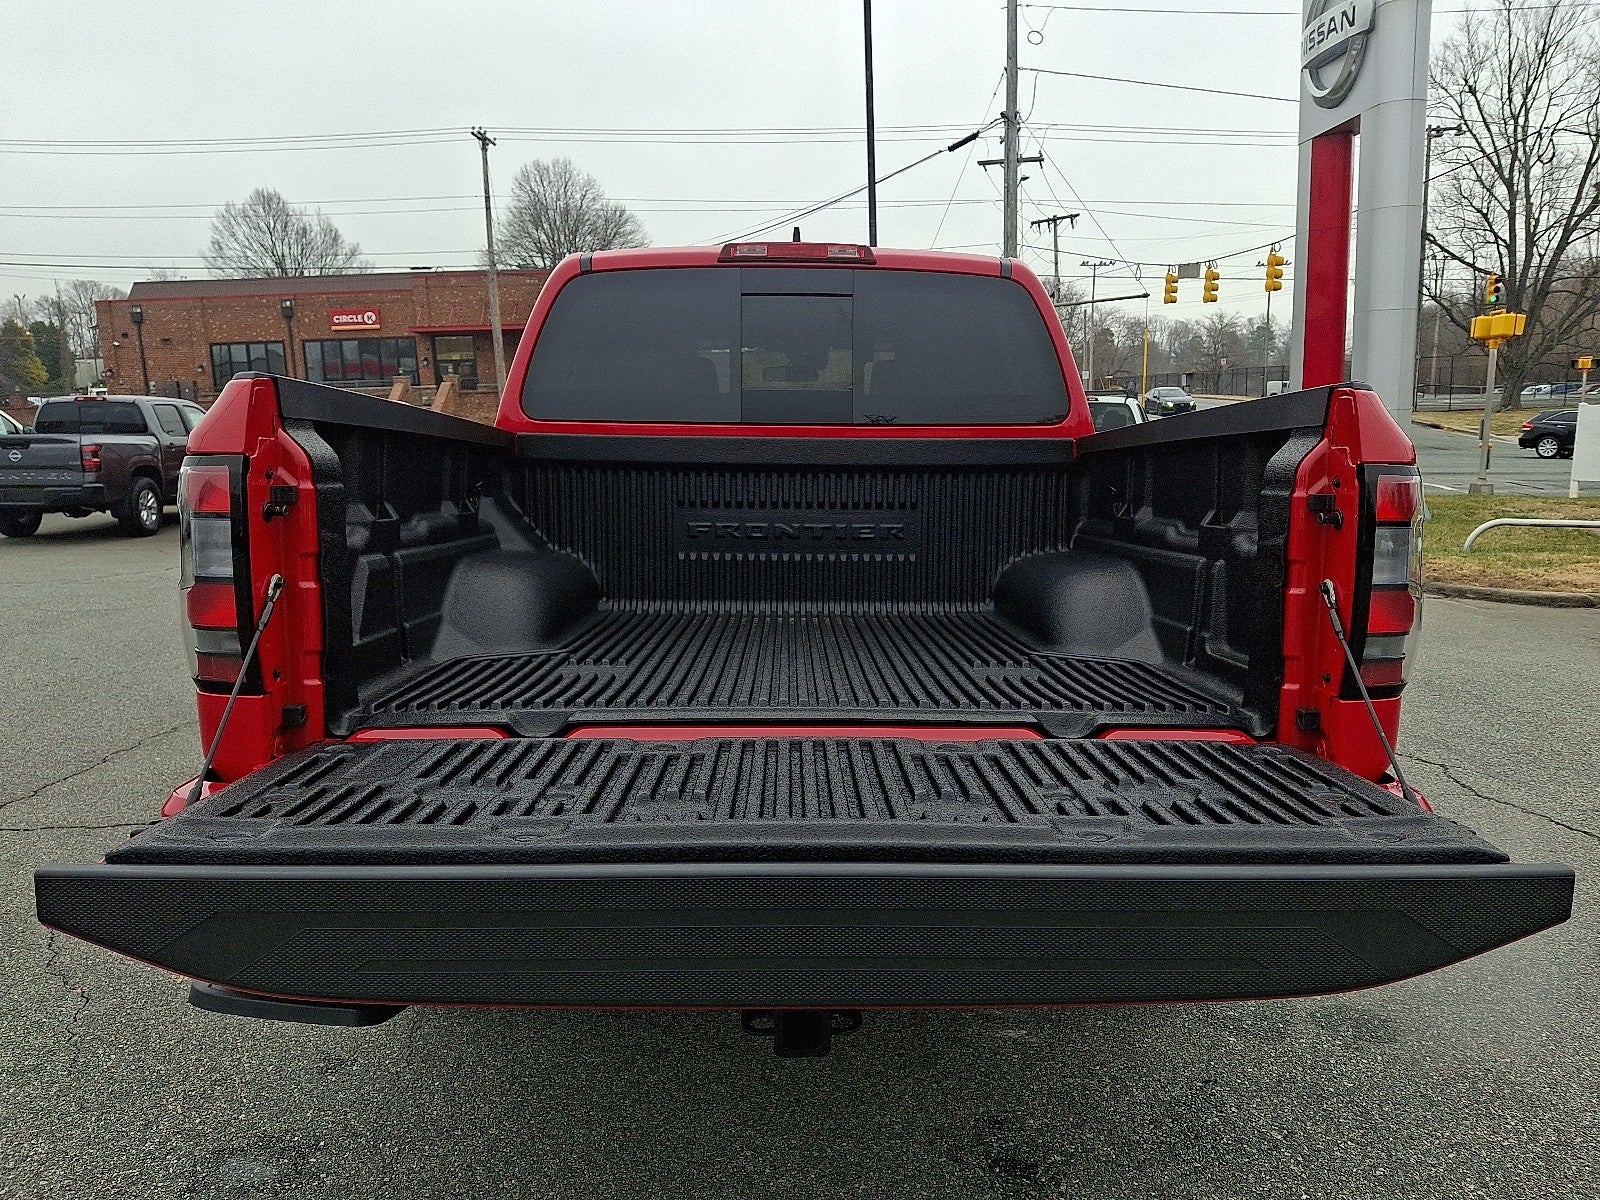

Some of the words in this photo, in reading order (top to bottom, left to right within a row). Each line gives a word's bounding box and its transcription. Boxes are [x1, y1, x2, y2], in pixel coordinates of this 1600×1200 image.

[1301, 4, 1357, 58] NISSAN
[333, 314, 363, 323] CIRCLE
[687, 521, 905, 540] FRONTIER
